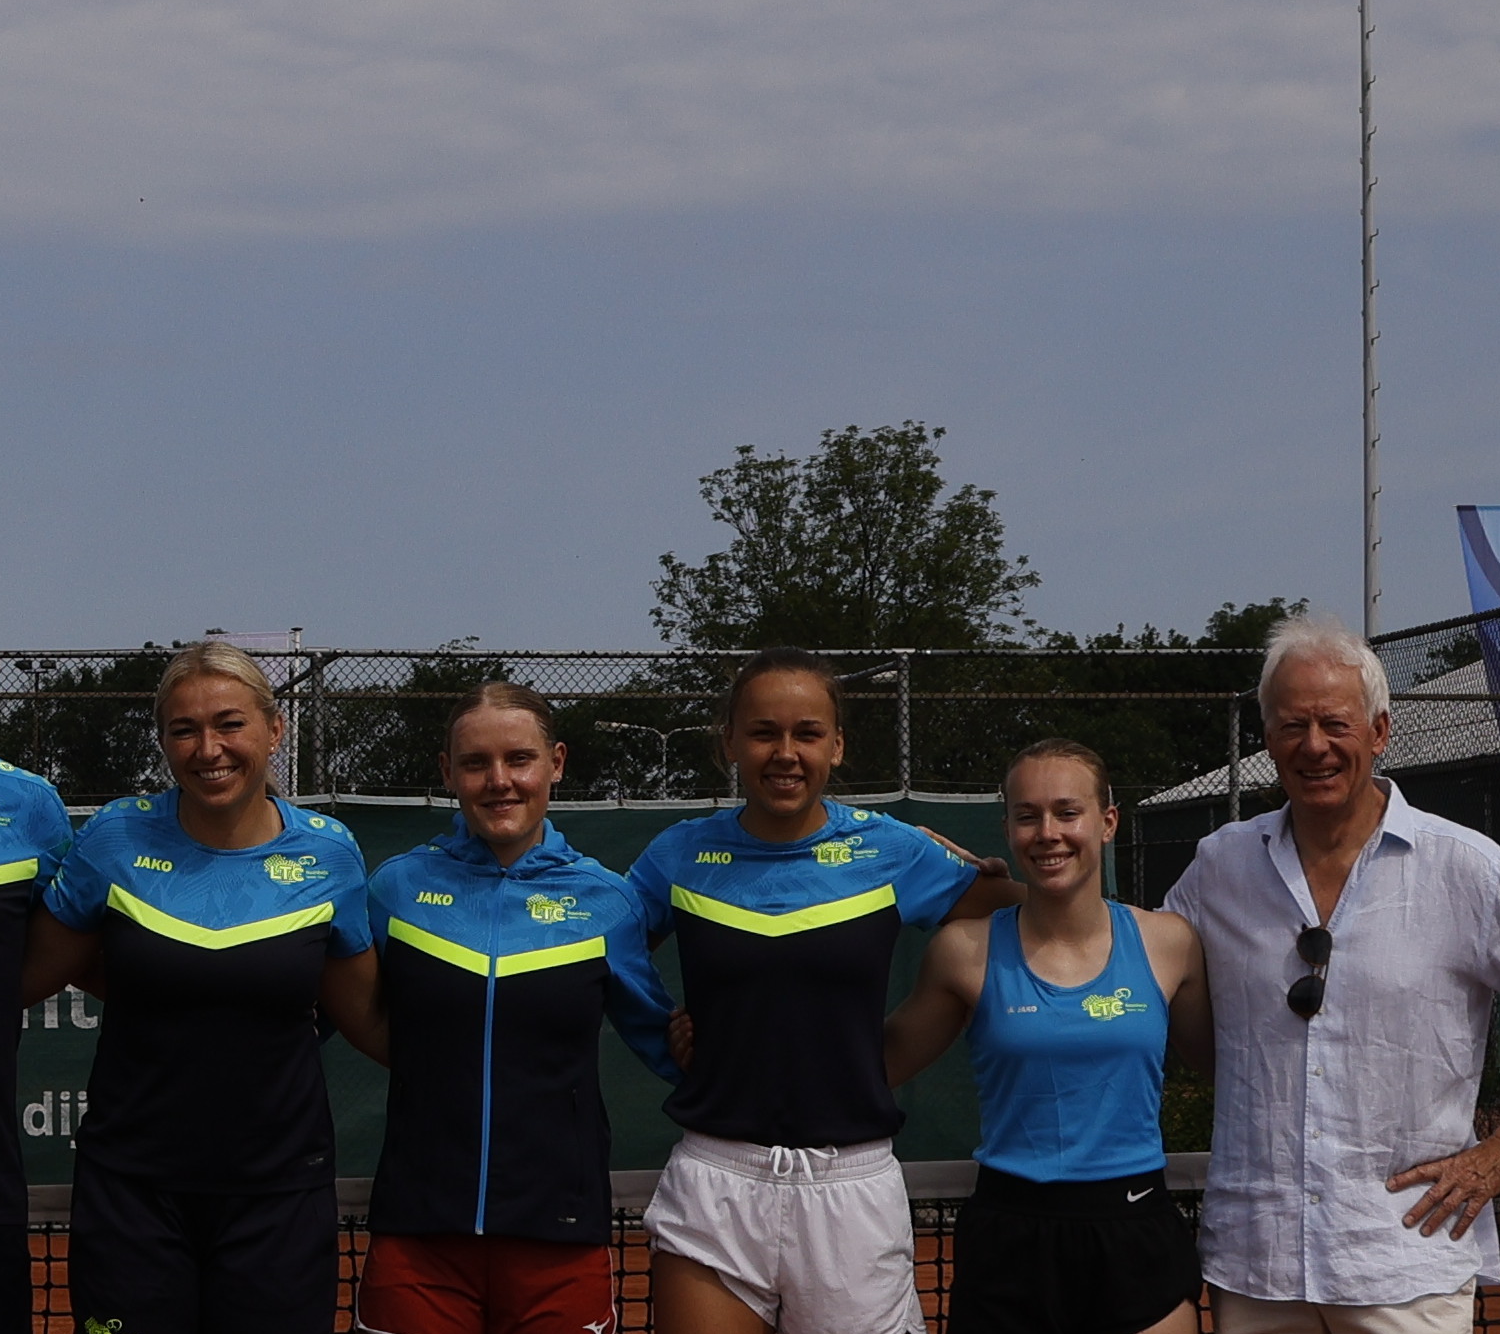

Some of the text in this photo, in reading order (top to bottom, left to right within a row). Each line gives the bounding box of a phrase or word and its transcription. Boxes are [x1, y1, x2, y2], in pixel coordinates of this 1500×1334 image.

[695, 851, 733, 865] JAKO
[815, 846, 854, 864] LTC
[133, 855, 173, 873] JAKO
[269, 866, 305, 882] LTC
[416, 891, 454, 906] JAKO
[530, 904, 567, 922] LTC
[1088, 1001, 1126, 1017] LTC
